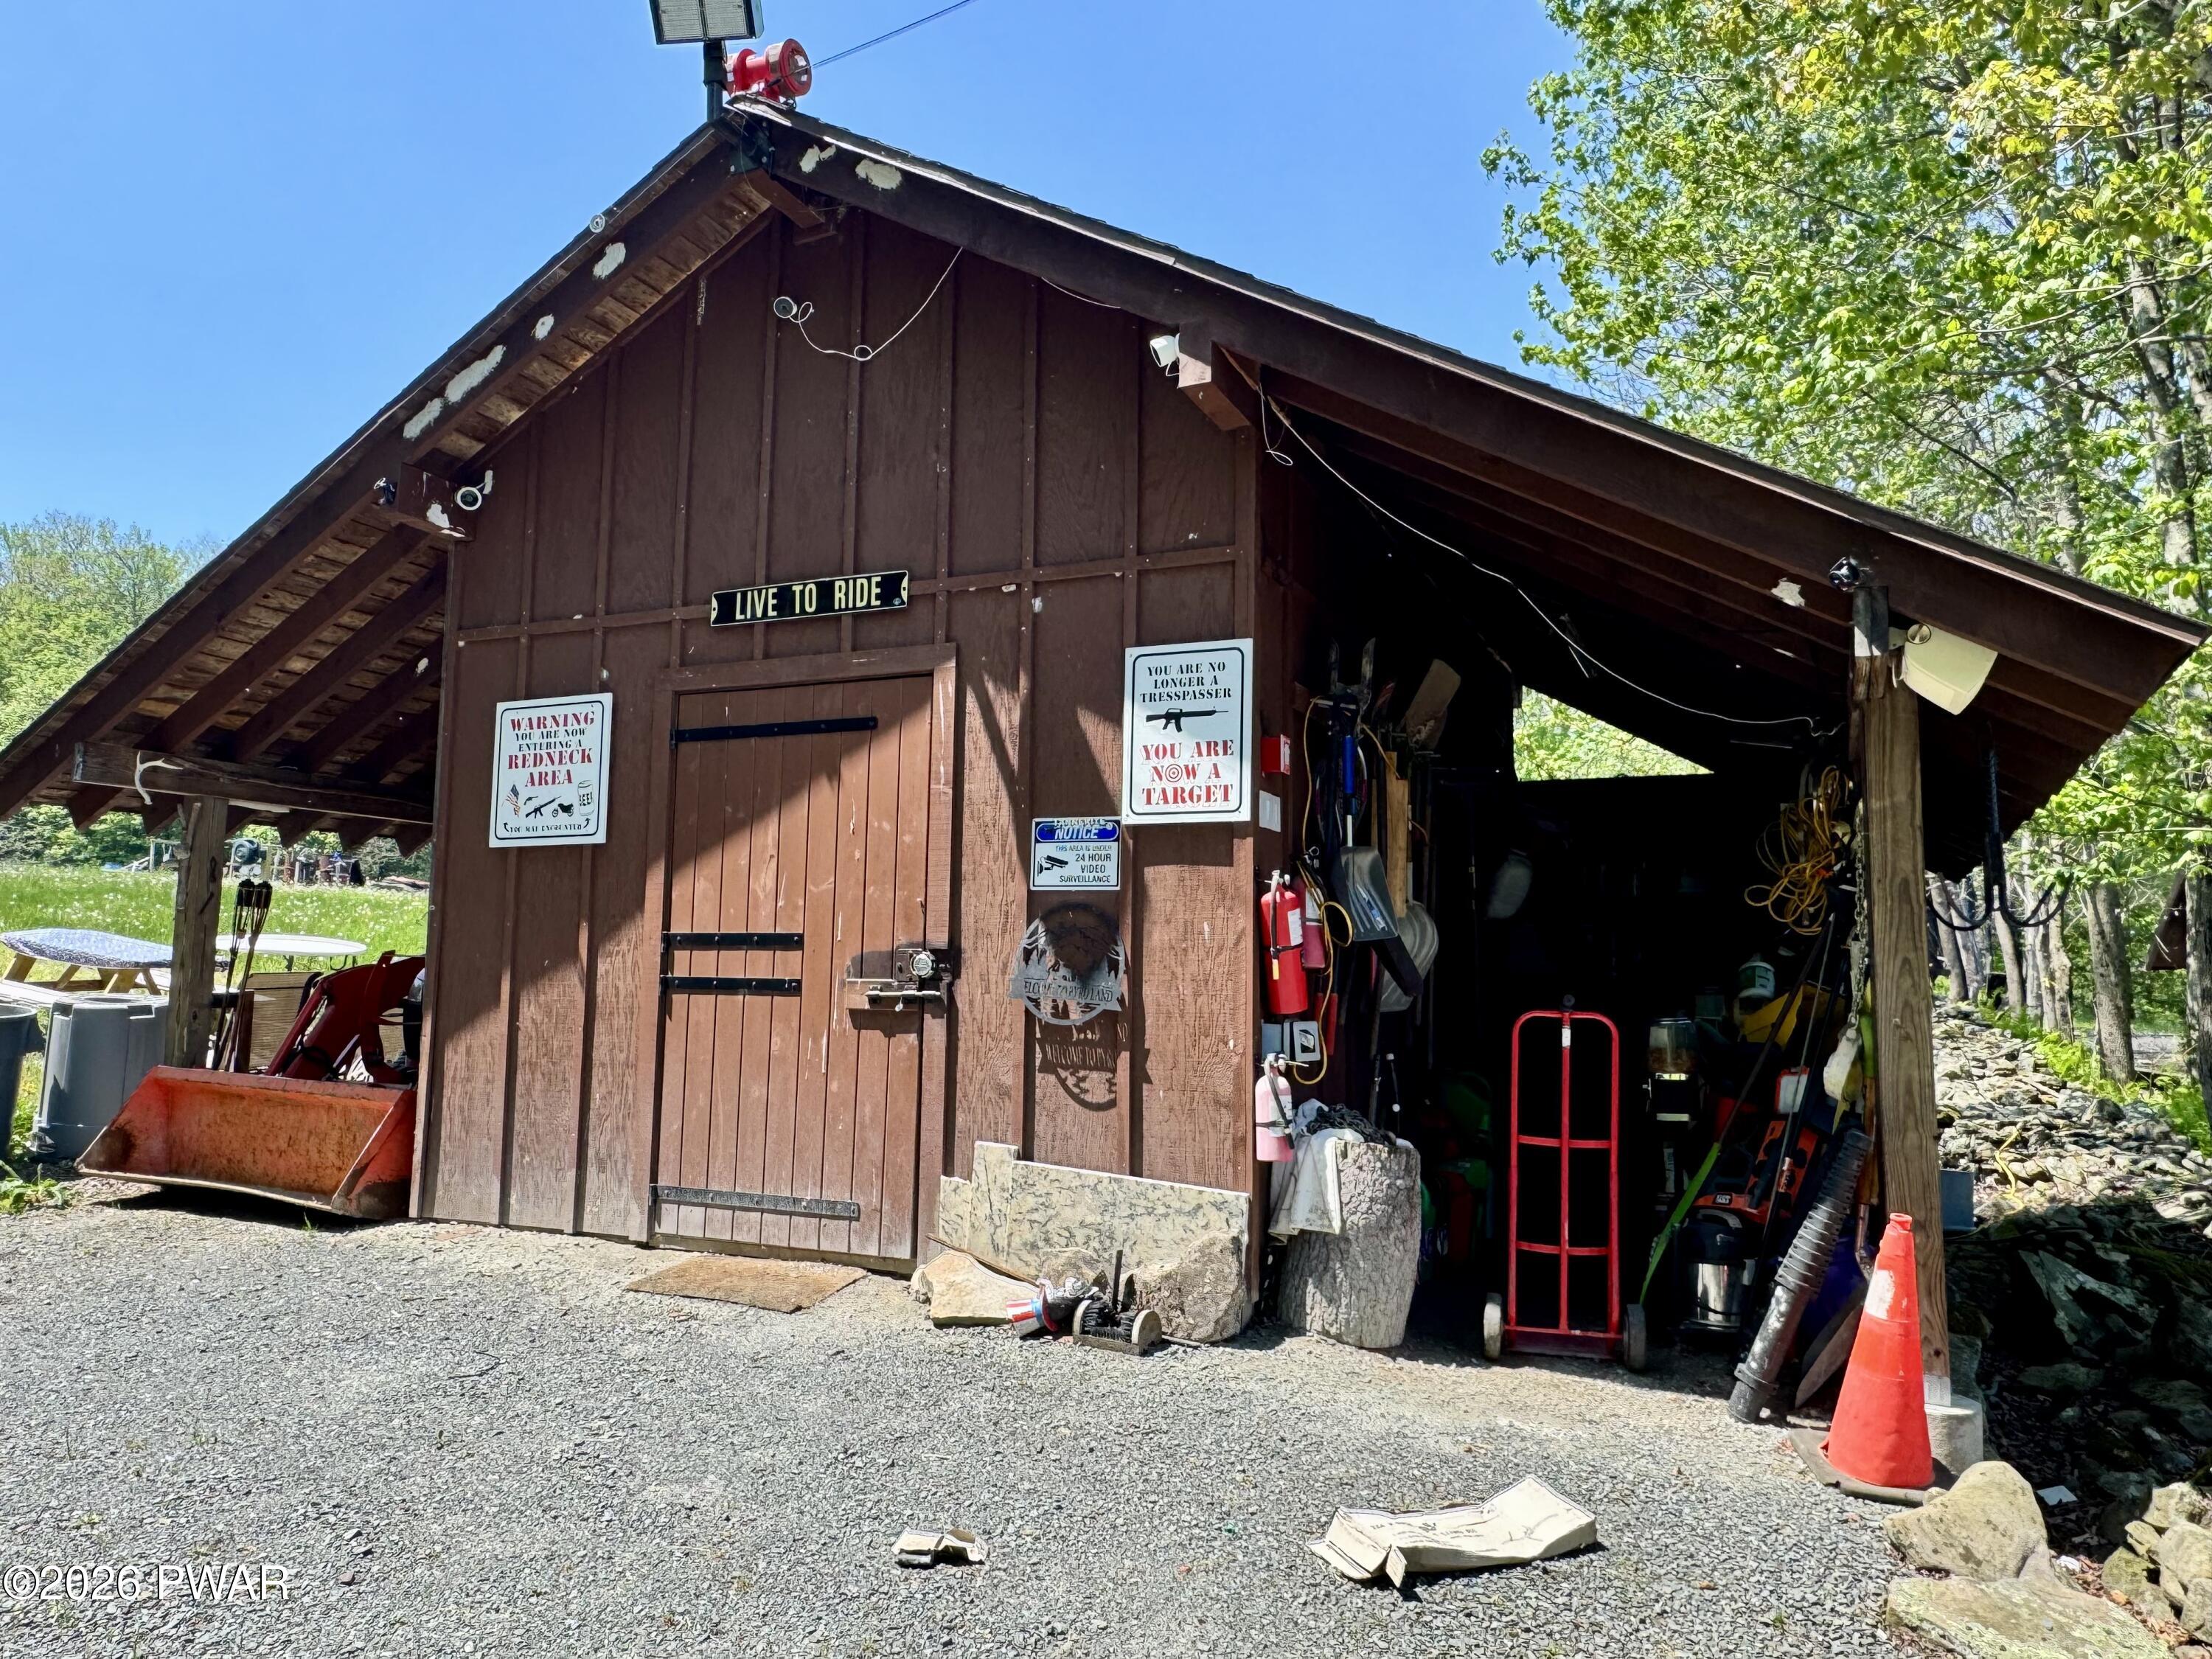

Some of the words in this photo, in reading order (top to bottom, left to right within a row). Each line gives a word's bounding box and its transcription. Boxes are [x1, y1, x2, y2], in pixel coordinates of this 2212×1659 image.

[735, 588, 778, 620] LIVE
[792, 583, 816, 614] TO
[834, 577, 881, 610] RIDE
[1147, 665, 1172, 676] YOU
[1177, 663, 1203, 675] ARE
[1208, 661, 1225, 672] NO
[1154, 676, 1204, 689] LONGER
[1210, 675, 1219, 686] A
[1140, 687, 1232, 703] TRESSPASSER
[510, 711, 595, 731] WARNING
[515, 731, 535, 742] YOU
[538, 729, 560, 740] ARE
[563, 727, 588, 738] NOW
[518, 739, 571, 752] ENTERING
[575, 739, 582, 748] A
[1142, 742, 1182, 761] YOU
[1189, 740, 1234, 759] ARE
[507, 748, 593, 770] REDNECK
[524, 769, 573, 787] AREA
[1151, 762, 1200, 784] NOW
[1207, 762, 1222, 779] A
[1141, 783, 1234, 806] TARGET
[1054, 826, 1099, 840] NOTICE
[1075, 853, 1085, 862] 24
[1088, 853, 1111, 862] HOUR
[1080, 864, 1106, 874] VIDEO
[1059, 875, 1111, 883] SURVEILLANCE
